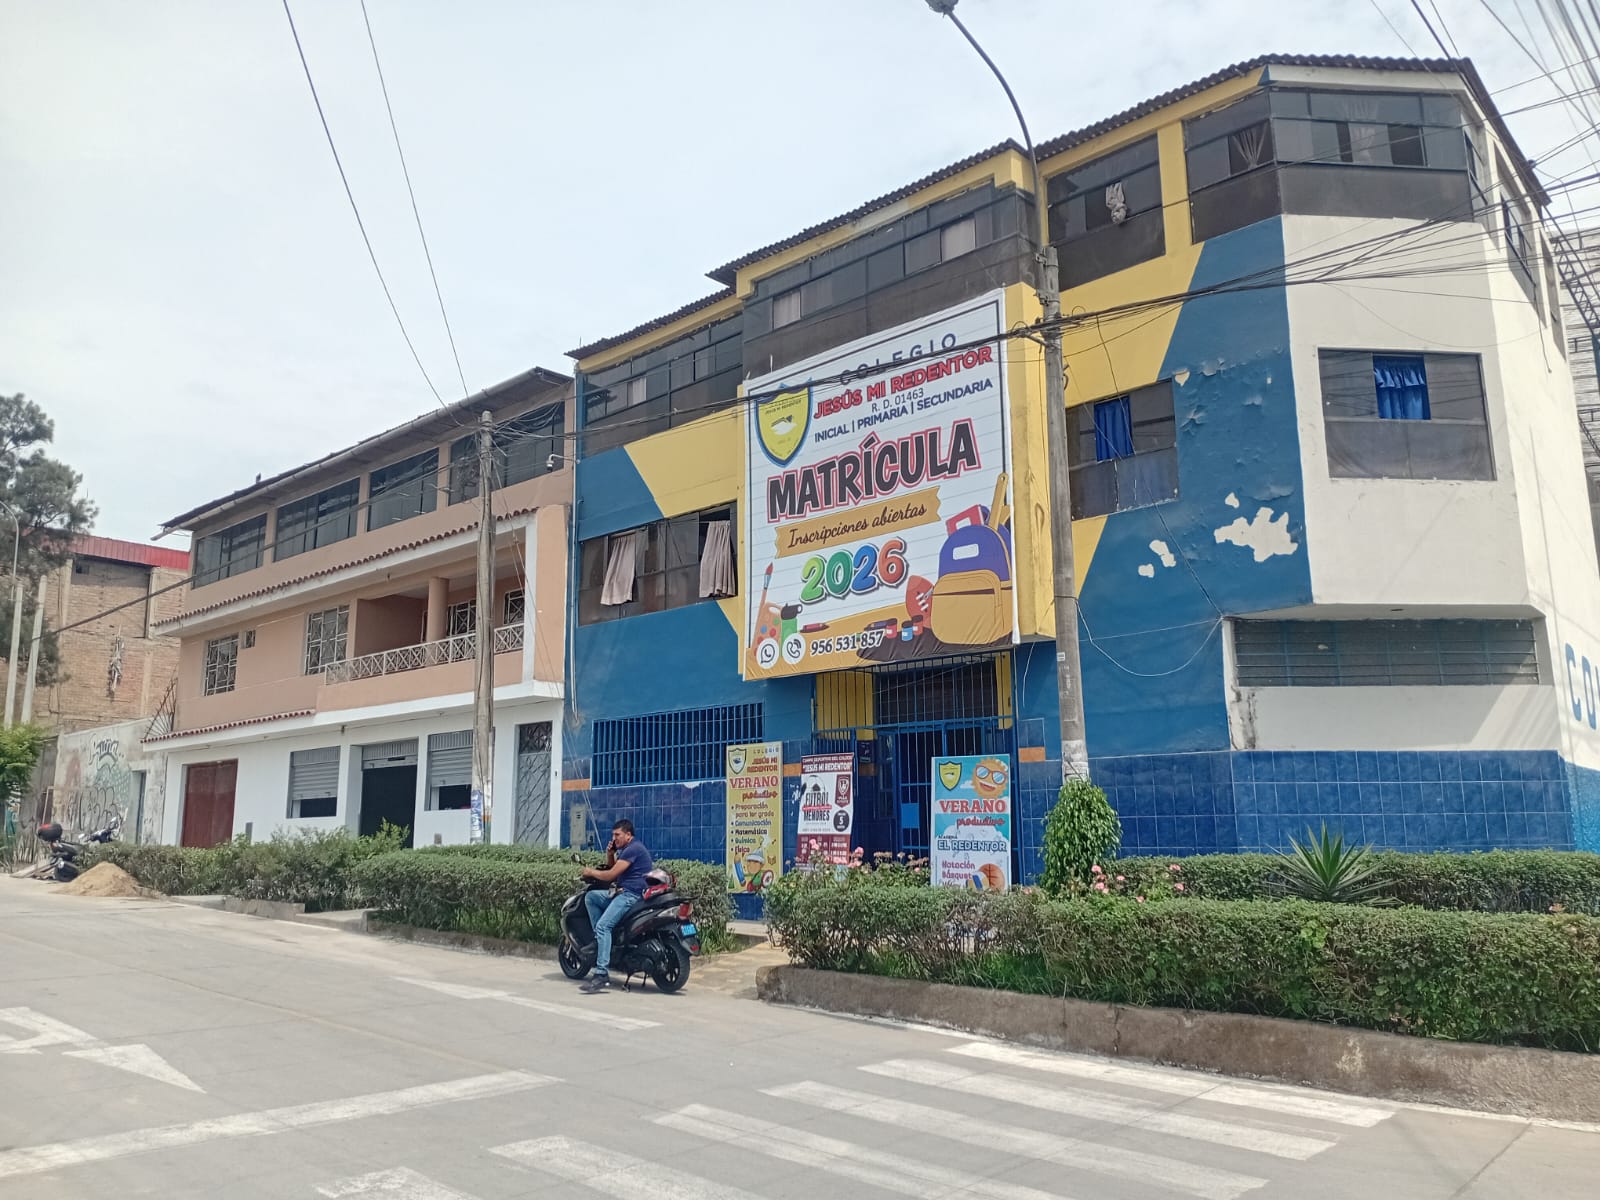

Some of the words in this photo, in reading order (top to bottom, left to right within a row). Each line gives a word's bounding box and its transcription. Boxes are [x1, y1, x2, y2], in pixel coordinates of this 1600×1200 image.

[813, 388, 862, 419] JESÚS
[866, 380, 887, 402] MI
[890, 346, 993, 396] REDENTOR
[871, 402, 881, 413] R.
[883, 398, 893, 409] D.
[894, 387, 925, 405] 01463
[814, 423, 850, 443] INICIAL
[857, 405, 908, 430] PRIMARIA
[916, 378, 994, 411] SECUNDARIA
[768, 418, 981, 523] MATRÍCULA
[787, 520, 869, 549] Inscripciones
[871, 501, 927, 528] abiertas
[800, 536, 909, 606] 2026
[810, 638, 834, 656] 956
[836, 635, 857, 653] 531
[860, 629, 886, 648] 857
[1565, 641, 1600, 731] CO
[730, 776, 778, 789] VERANO
[939, 799, 1006, 813] VERANO
[956, 814, 1005, 829] productivo
[937, 839, 951, 851] EL
[951, 840, 1008, 852] REDENTOR
